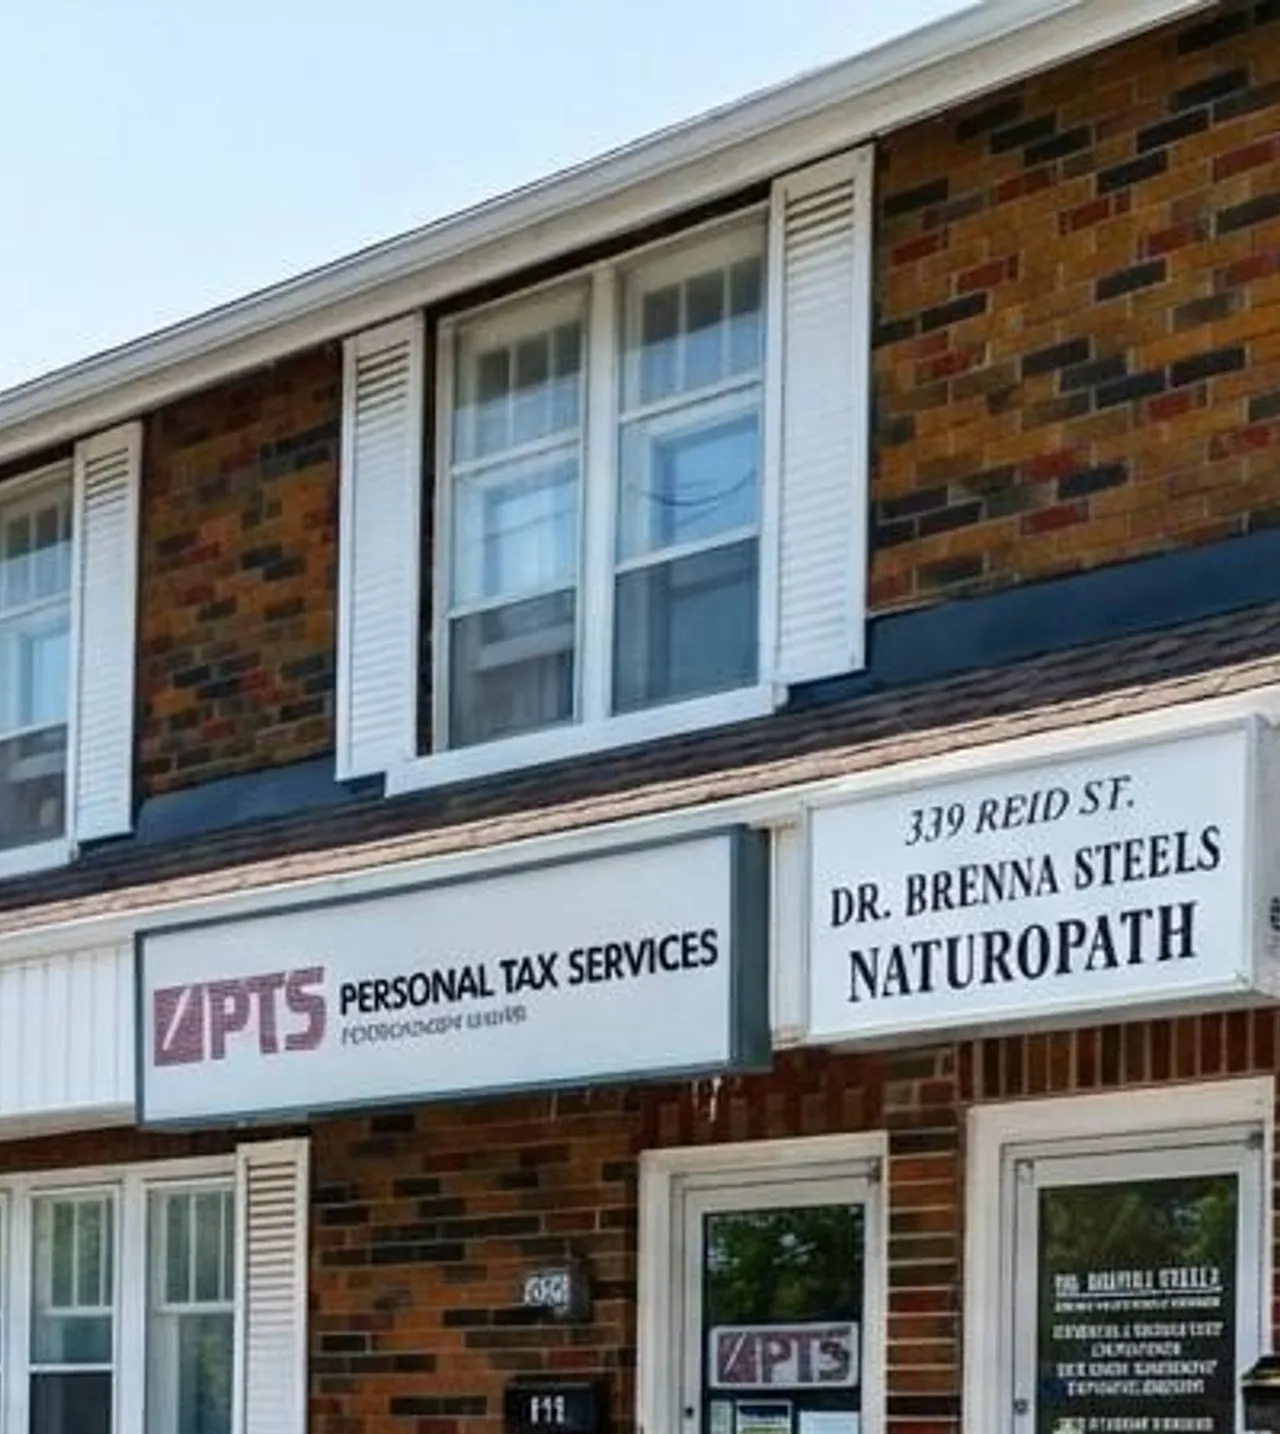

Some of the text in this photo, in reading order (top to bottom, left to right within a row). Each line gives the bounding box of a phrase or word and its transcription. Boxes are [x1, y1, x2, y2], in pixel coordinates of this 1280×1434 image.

[904, 775, 1135, 846] 339 REID ST.
[829, 825, 1222, 927] DR. BRENNA STEELS
[340, 928, 718, 1016] PERSONAL TAX SERVICES
[848, 901, 1199, 1003] NATUROPATH
